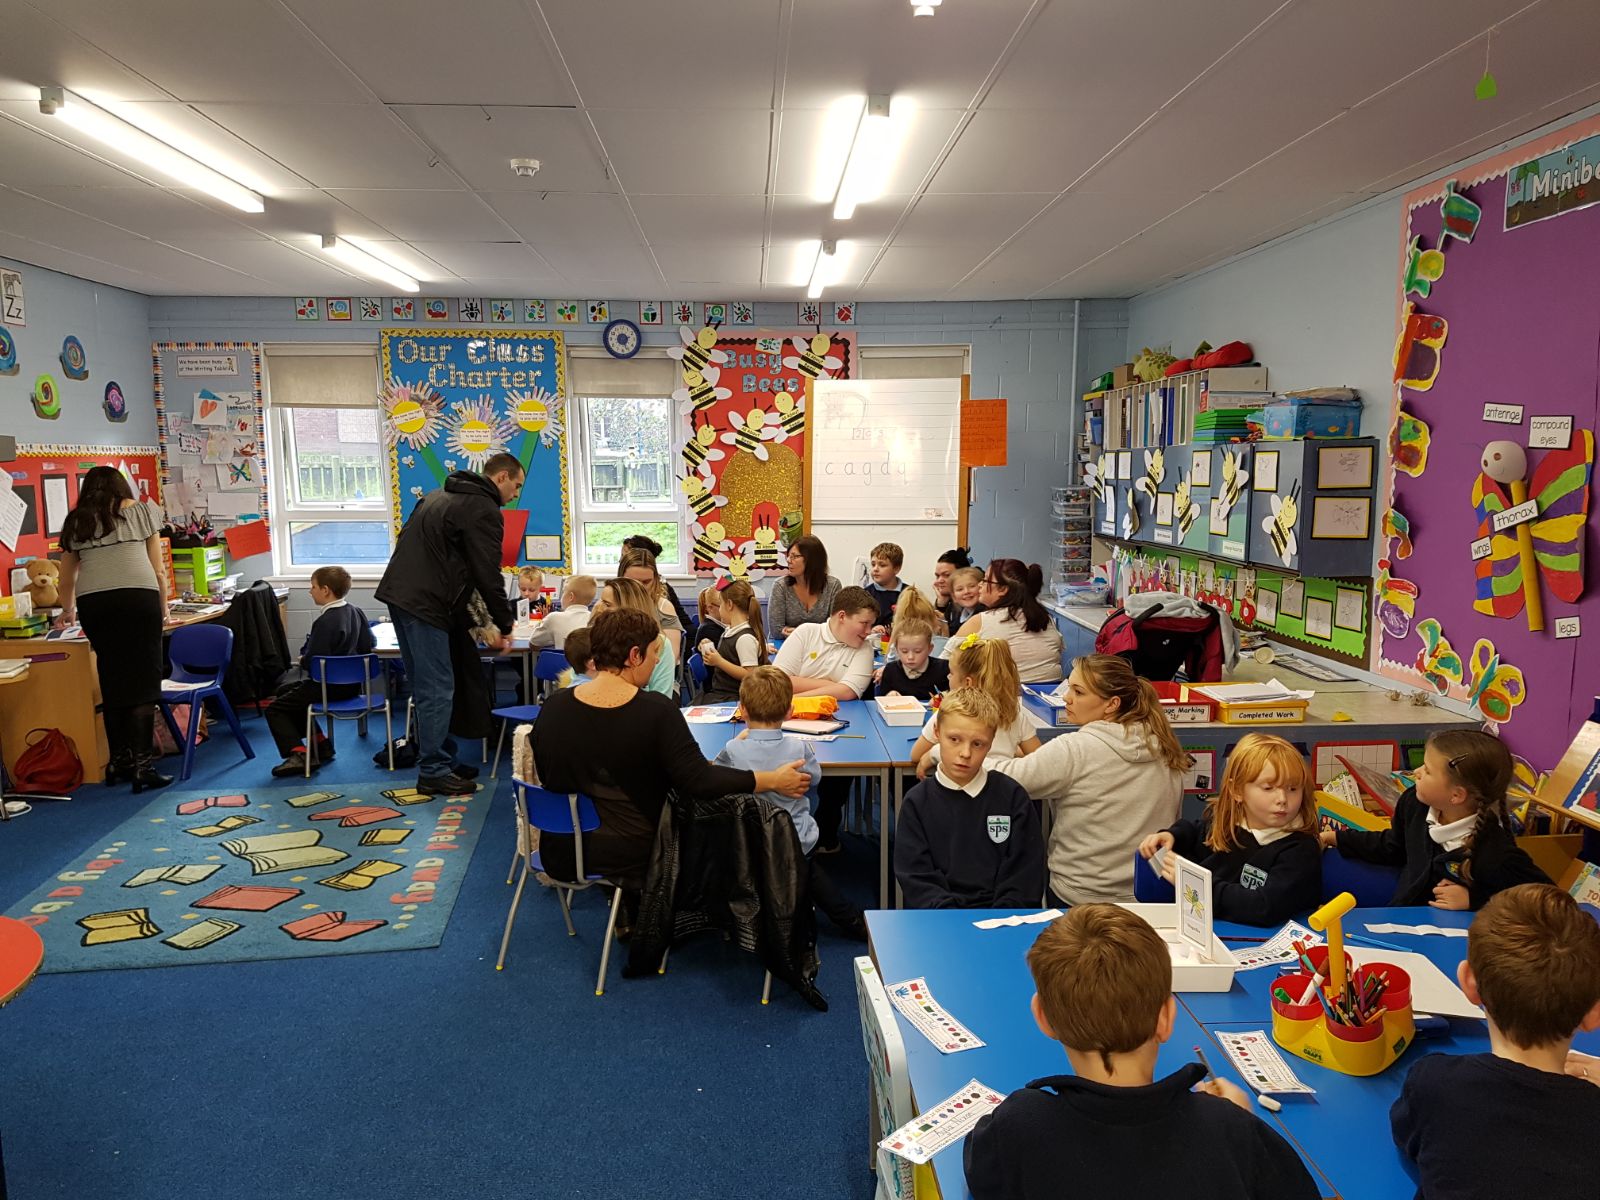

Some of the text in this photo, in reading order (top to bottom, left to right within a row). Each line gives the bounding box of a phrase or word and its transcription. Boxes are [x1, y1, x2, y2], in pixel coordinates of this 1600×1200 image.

[5, 296, 23, 320] Zz
[398, 339, 453, 364] Our
[722, 349, 783, 375] Busy
[428, 362, 542, 389] Charter
[742, 373, 799, 393] Bees
[1532, 418, 1570, 431] compound
[1540, 436, 1558, 446] eyes
[1496, 506, 1535, 527] thorax
[1473, 543, 1490, 556] wings
[1559, 622, 1576, 636] legs
[1238, 712, 1274, 720] Completed
[990, 826, 1008, 838] sps
